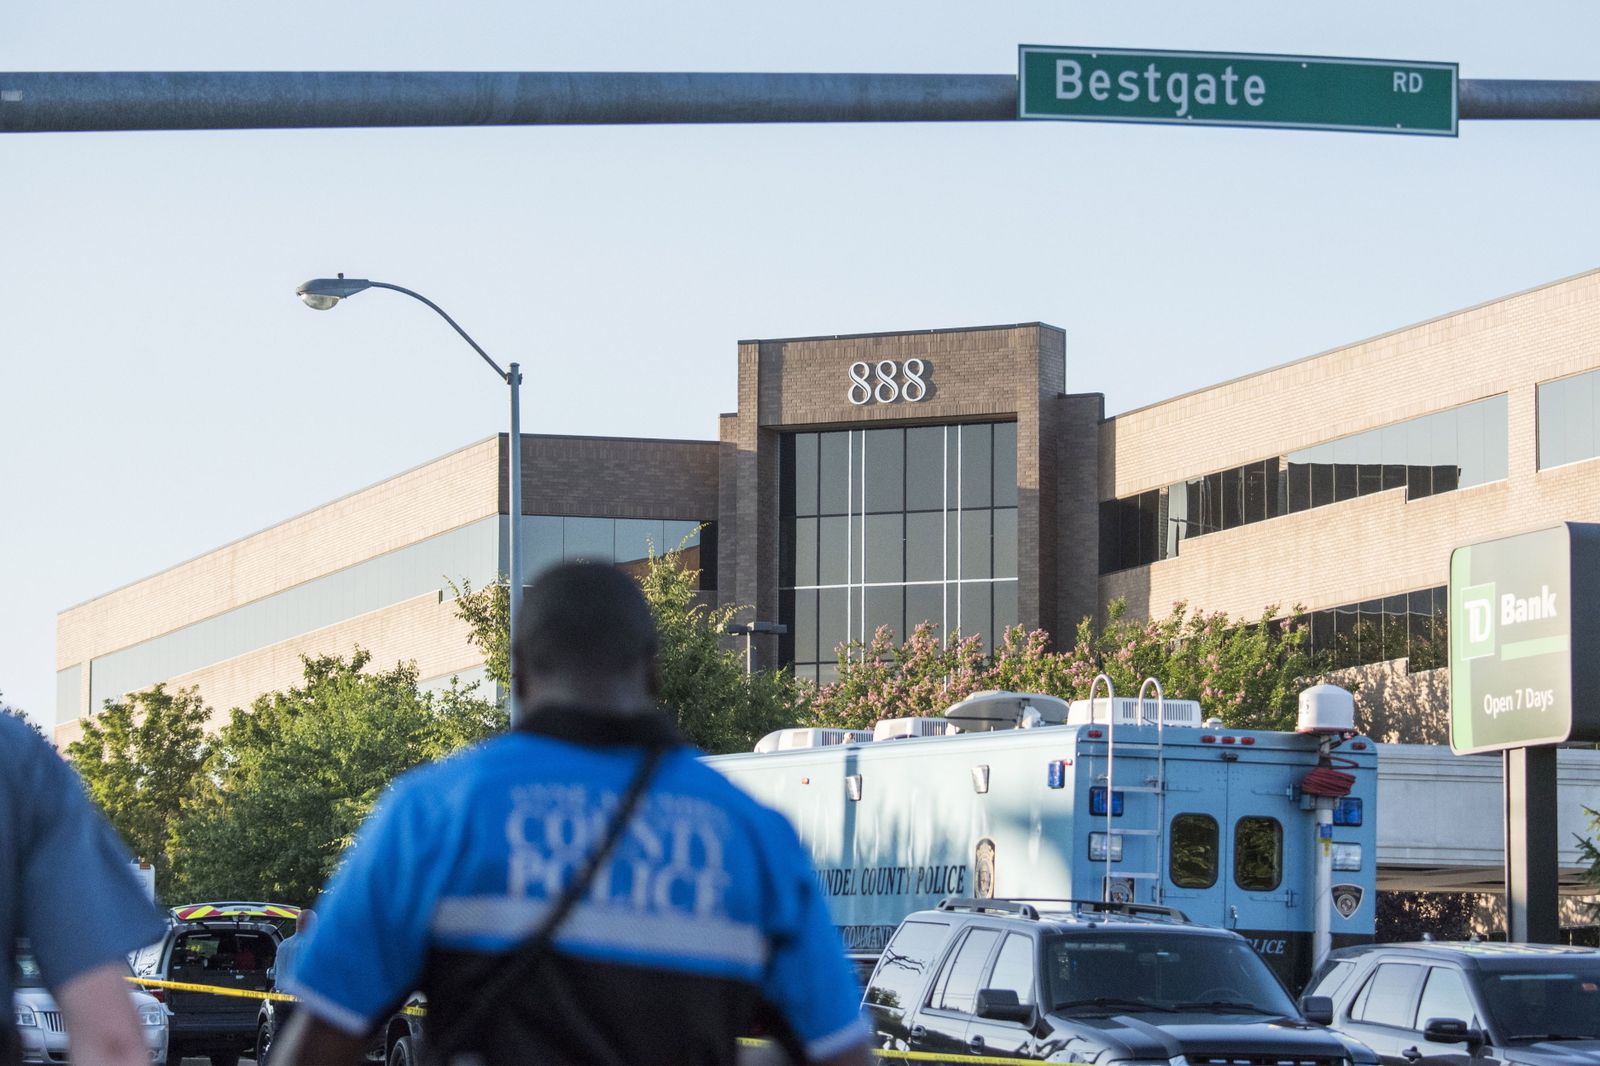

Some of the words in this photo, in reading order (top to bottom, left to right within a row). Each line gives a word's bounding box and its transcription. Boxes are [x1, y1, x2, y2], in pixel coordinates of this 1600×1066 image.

[1055, 59, 1266, 116] Bestgate
[1393, 72, 1423, 93] RD
[847, 358, 926, 405] 888
[1463, 598, 1492, 644] TD
[1500, 585, 1557, 626] Bank
[1483, 693, 1513, 719] Open
[1515, 689, 1523, 710] 7
[1525, 687, 1554, 712] Days
[861, 866, 914, 896] COUNTY
[915, 864, 967, 896] POLICE
[1249, 939, 1286, 954] LICE
